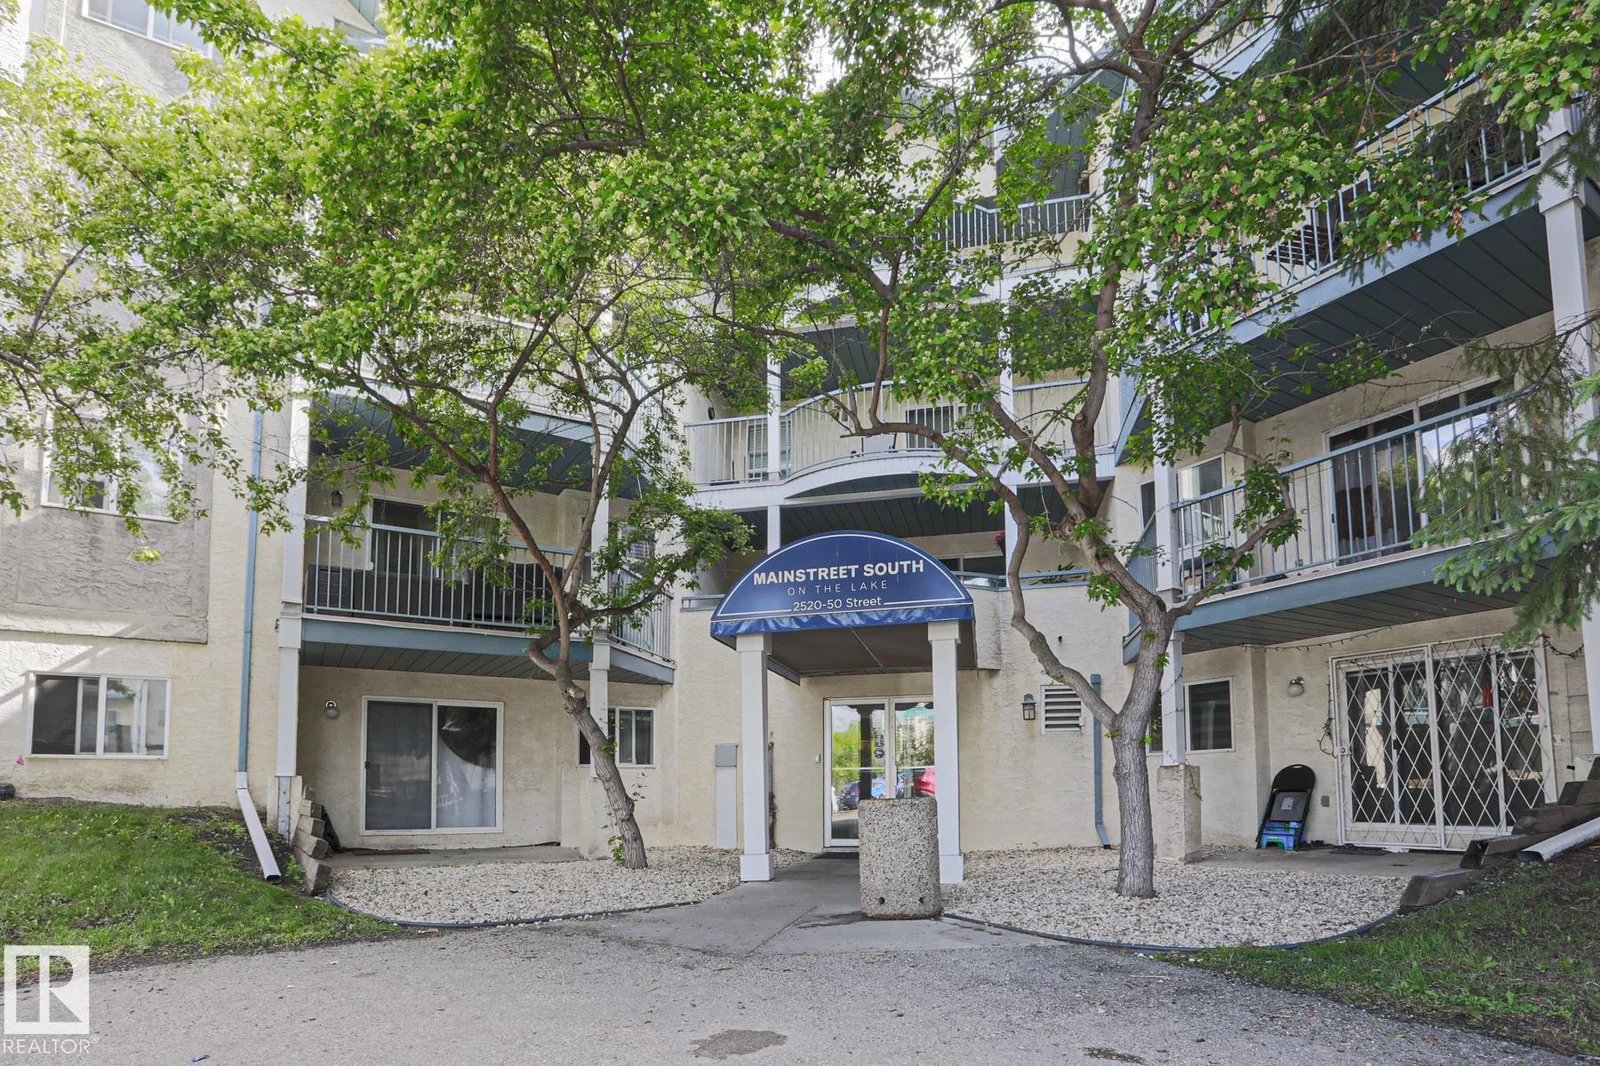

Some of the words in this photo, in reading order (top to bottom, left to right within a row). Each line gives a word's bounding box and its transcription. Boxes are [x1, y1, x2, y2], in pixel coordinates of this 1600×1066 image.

[753, 565, 859, 585] MAINSTREET
[863, 560, 924, 577] SOUTH
[787, 586, 806, 596] ON
[815, 584, 842, 593] THE
[851, 580, 888, 591] LAKE
[793, 599, 843, 612] 2520-50
[846, 596, 882, 608] Street
